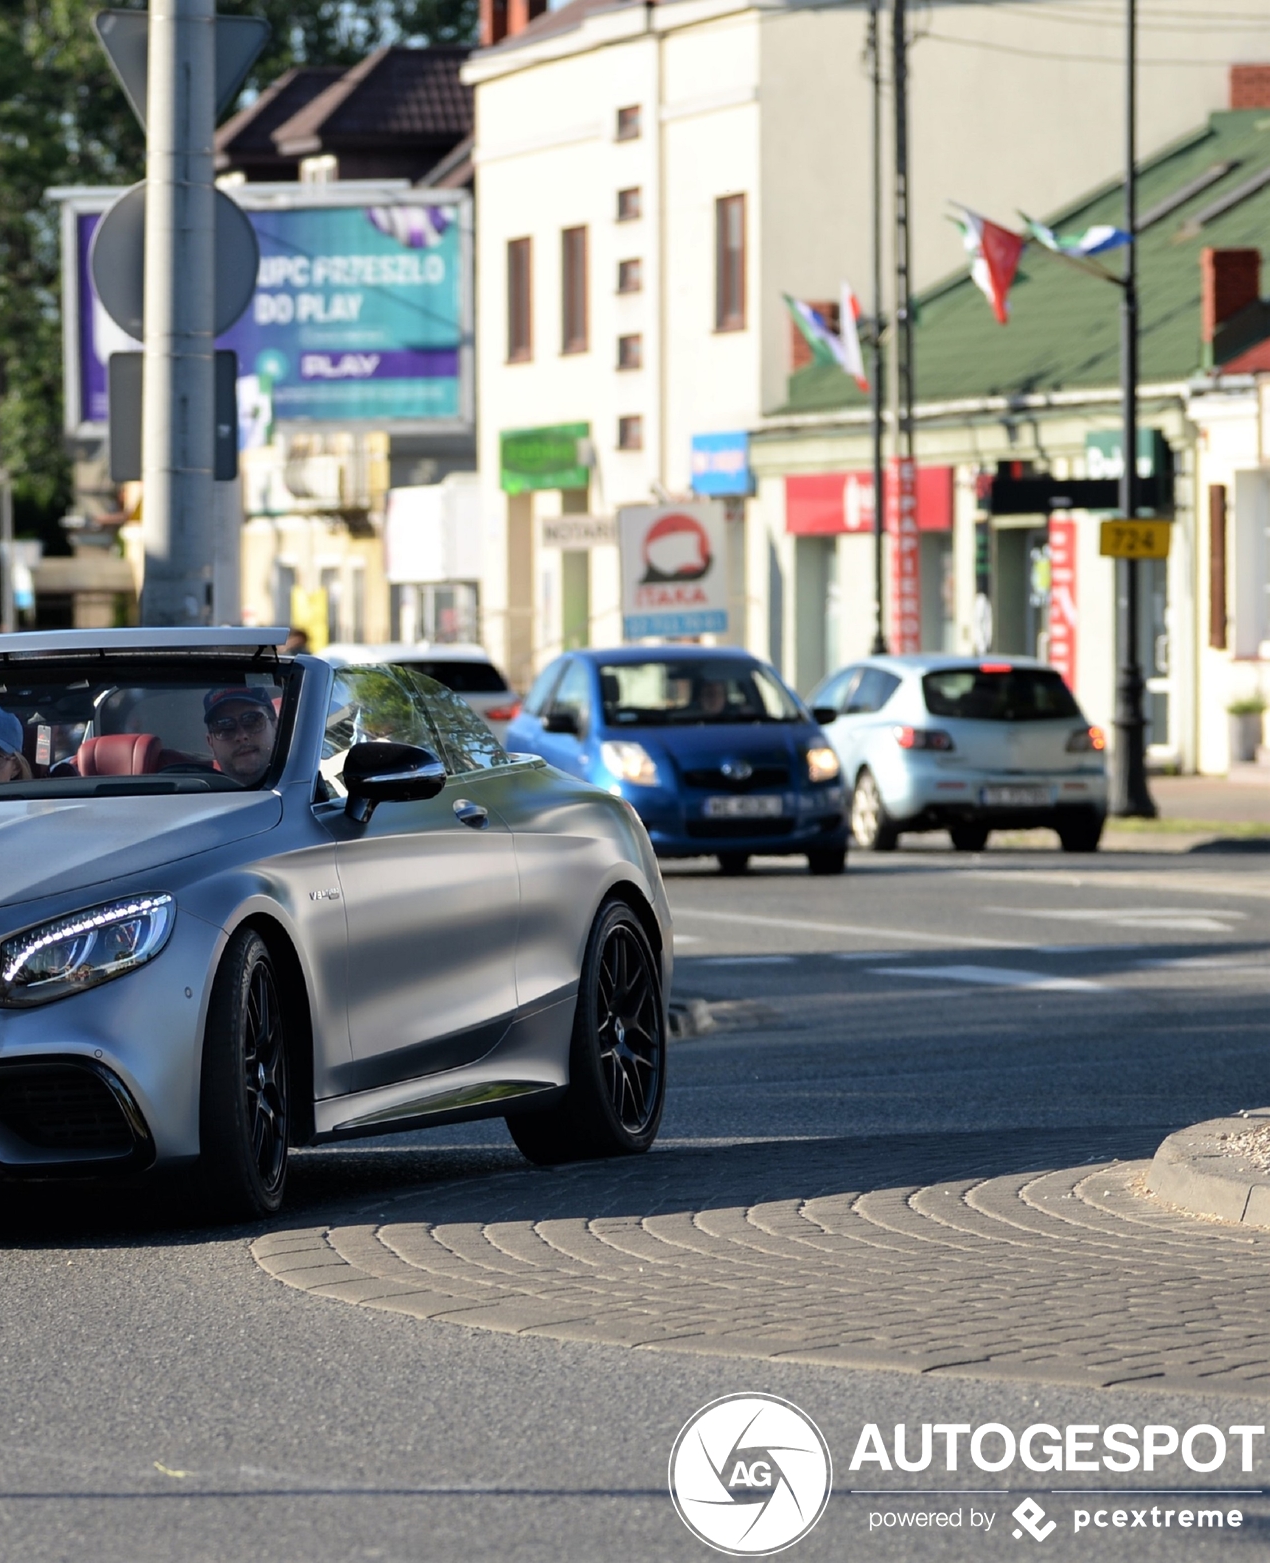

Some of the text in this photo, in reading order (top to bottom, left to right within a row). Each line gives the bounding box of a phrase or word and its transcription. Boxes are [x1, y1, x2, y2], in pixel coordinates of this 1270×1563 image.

[257, 255, 310, 287] UPC
[254, 293, 363, 325] DO PLAY
[302, 354, 380, 378] PLAY
[1113, 526, 1156, 551] 724
[634, 586, 708, 609] ITAKA
